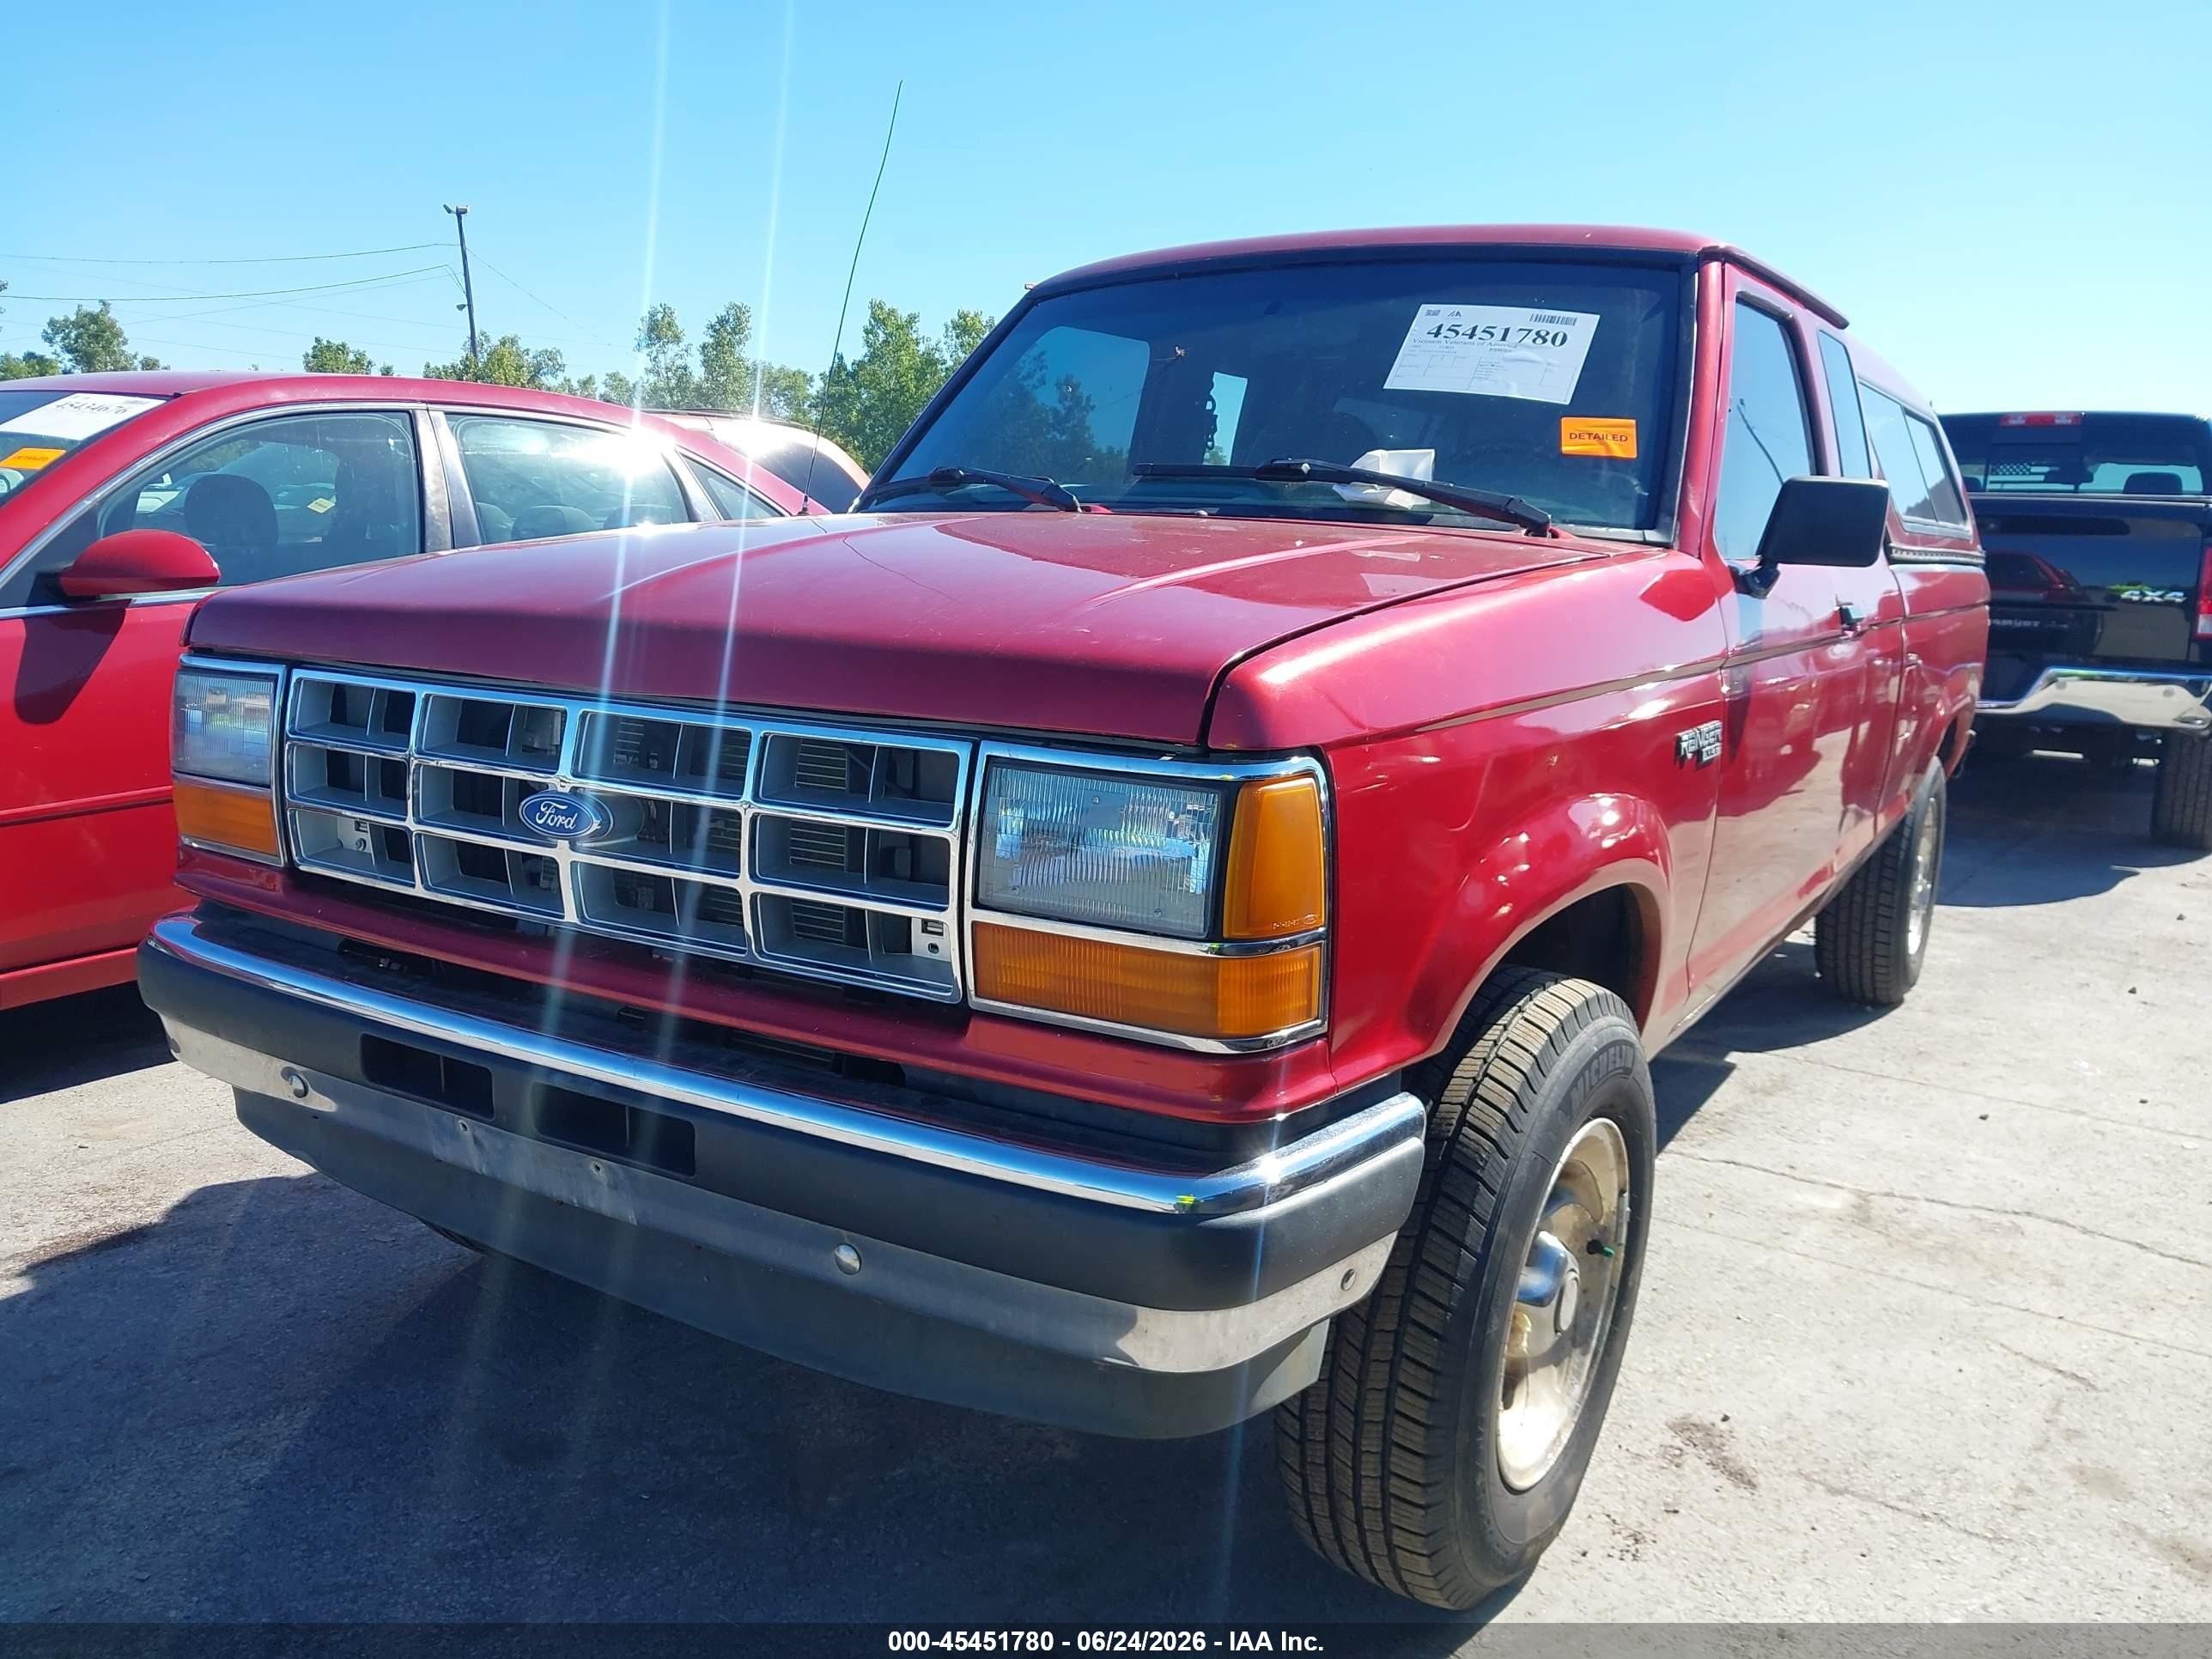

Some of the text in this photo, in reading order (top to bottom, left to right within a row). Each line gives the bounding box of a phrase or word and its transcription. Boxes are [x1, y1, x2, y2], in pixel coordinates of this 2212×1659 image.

[1426, 323, 1569, 348] 45451780
[1569, 432, 1628, 442] DETAILED
[1679, 726, 1722, 759] RANGER
[535, 800, 578, 830] Ford
[1570, 1044, 1634, 1119] MICHELIN
